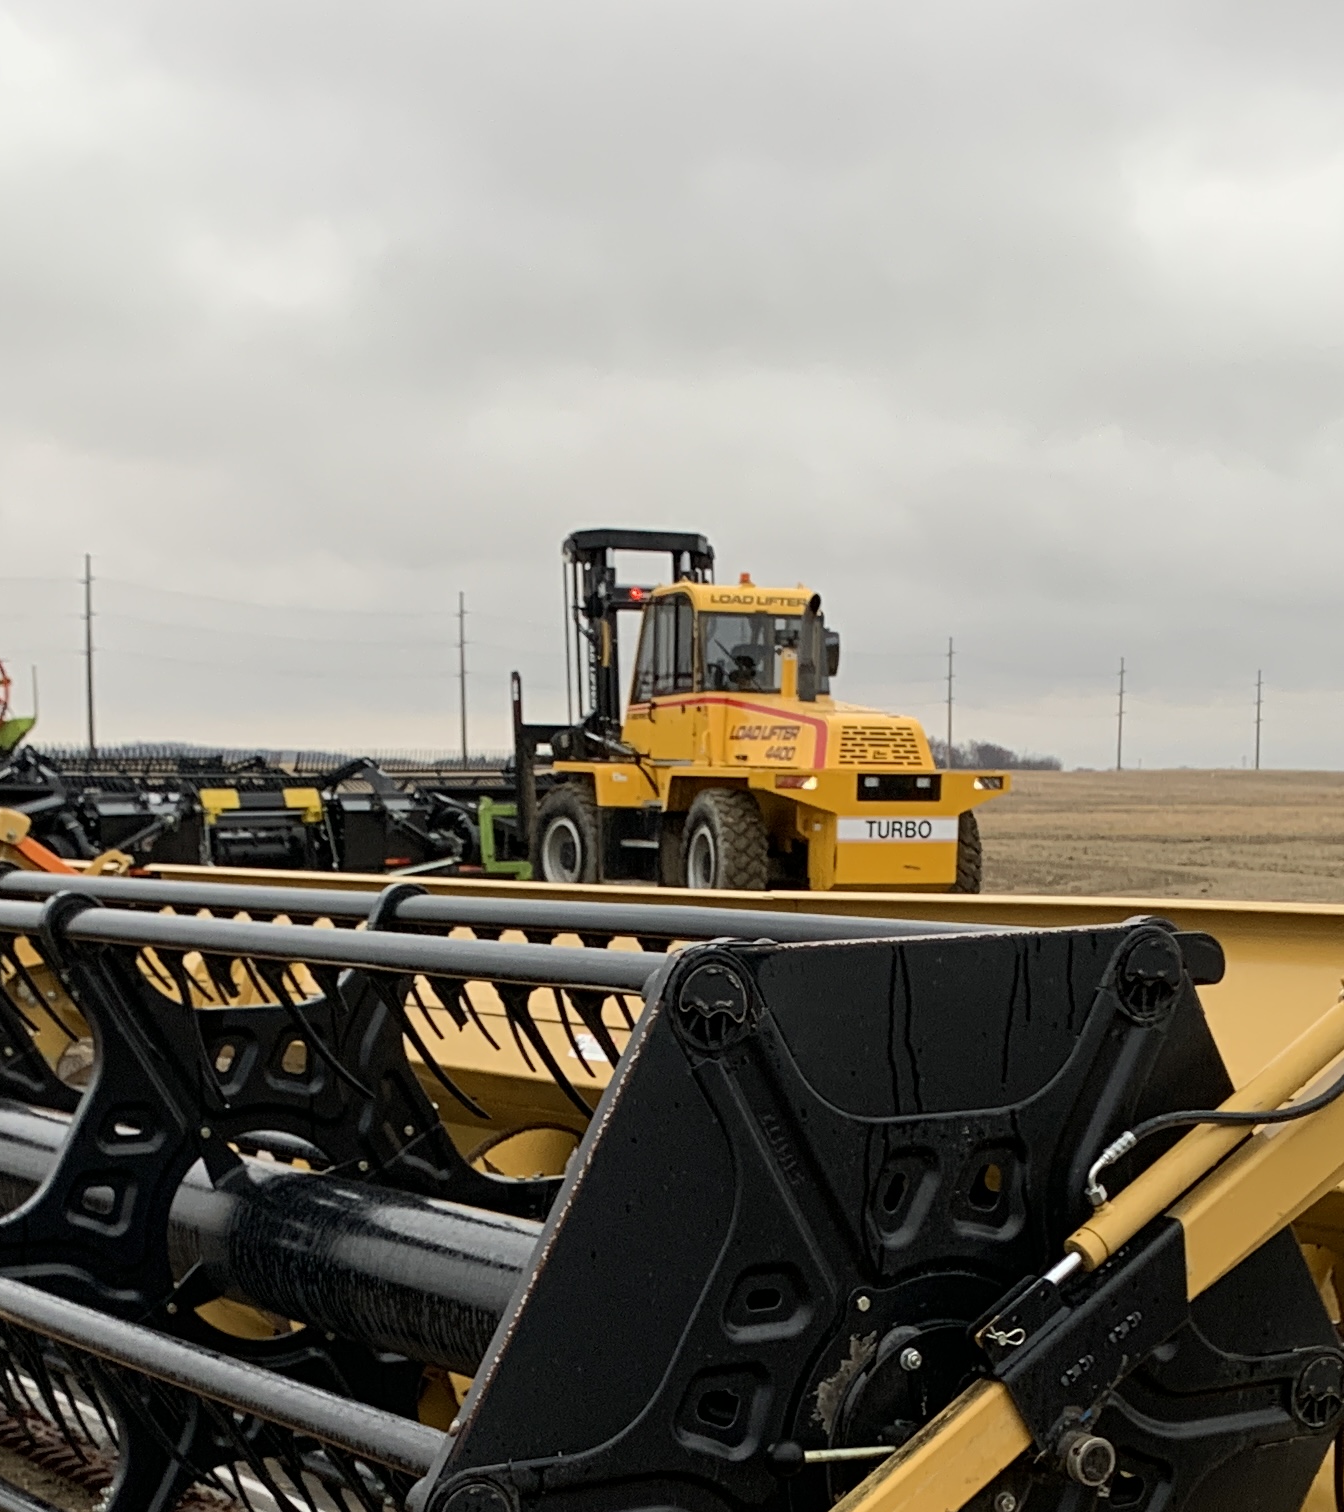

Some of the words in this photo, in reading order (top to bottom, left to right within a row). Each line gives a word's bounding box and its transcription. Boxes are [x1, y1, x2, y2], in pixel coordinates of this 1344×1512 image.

[710, 594, 754, 605] LOAD
[756, 596, 808, 607] LIFTER
[729, 725, 762, 740] LOAD
[761, 725, 801, 740] LIFTER
[865, 820, 932, 839] TURBO
